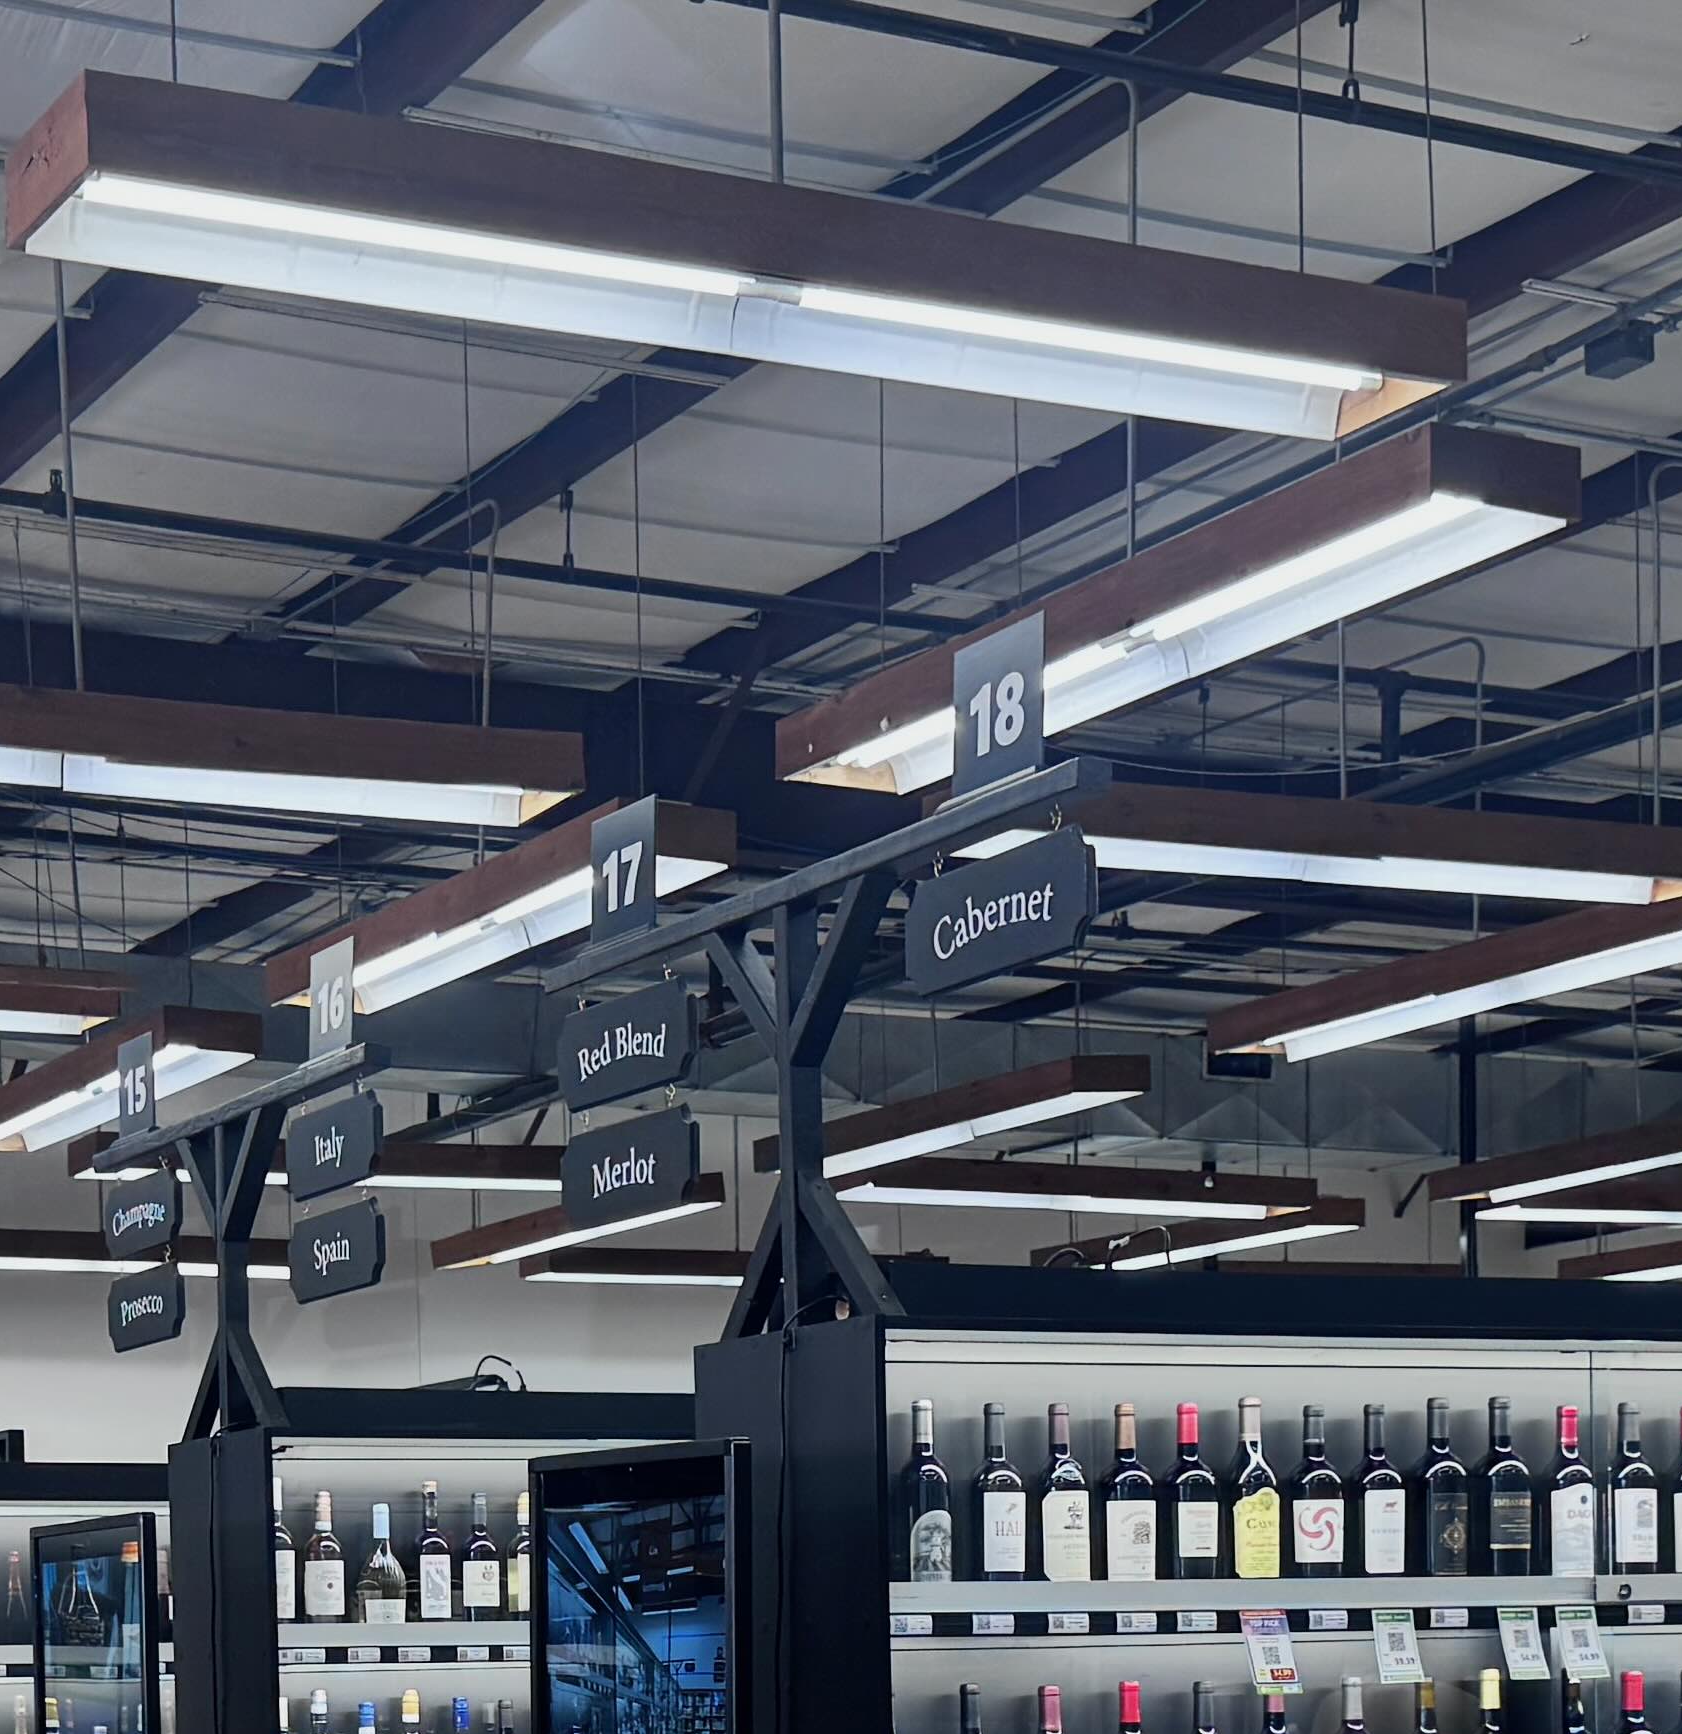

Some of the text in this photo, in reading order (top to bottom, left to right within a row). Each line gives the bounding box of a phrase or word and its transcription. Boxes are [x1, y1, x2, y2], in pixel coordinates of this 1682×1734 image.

[969, 671, 1025, 757] 18
[602, 840, 643, 913] 17
[932, 883, 1054, 960] Cabernet
[316, 975, 345, 1034] 16
[577, 1021, 666, 1082] Red Blend
[123, 1064, 146, 1116] 15
[313, 1126, 345, 1168] Italy
[591, 1146, 656, 1198] Merlot
[112, 1202, 166, 1237] Champagne
[312, 1230, 351, 1276] Spain
[120, 1293, 164, 1326] Prosecco
